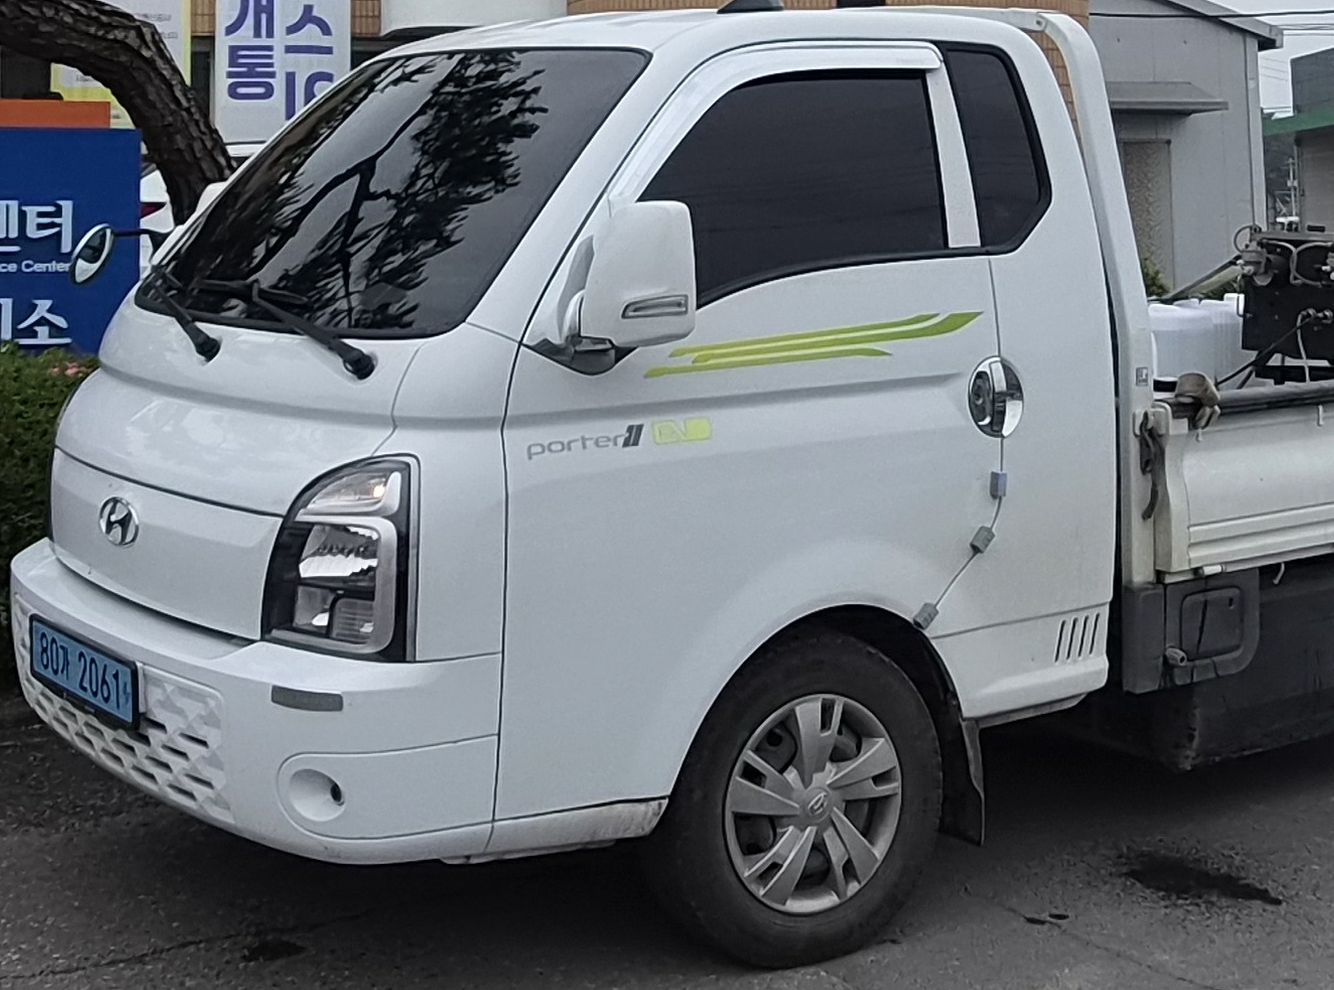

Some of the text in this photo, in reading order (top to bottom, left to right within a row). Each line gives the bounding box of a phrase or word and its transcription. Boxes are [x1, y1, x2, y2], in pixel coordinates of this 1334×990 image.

[21, 259, 71, 273] Center
[39, 631, 120, 710] 80가 2061
